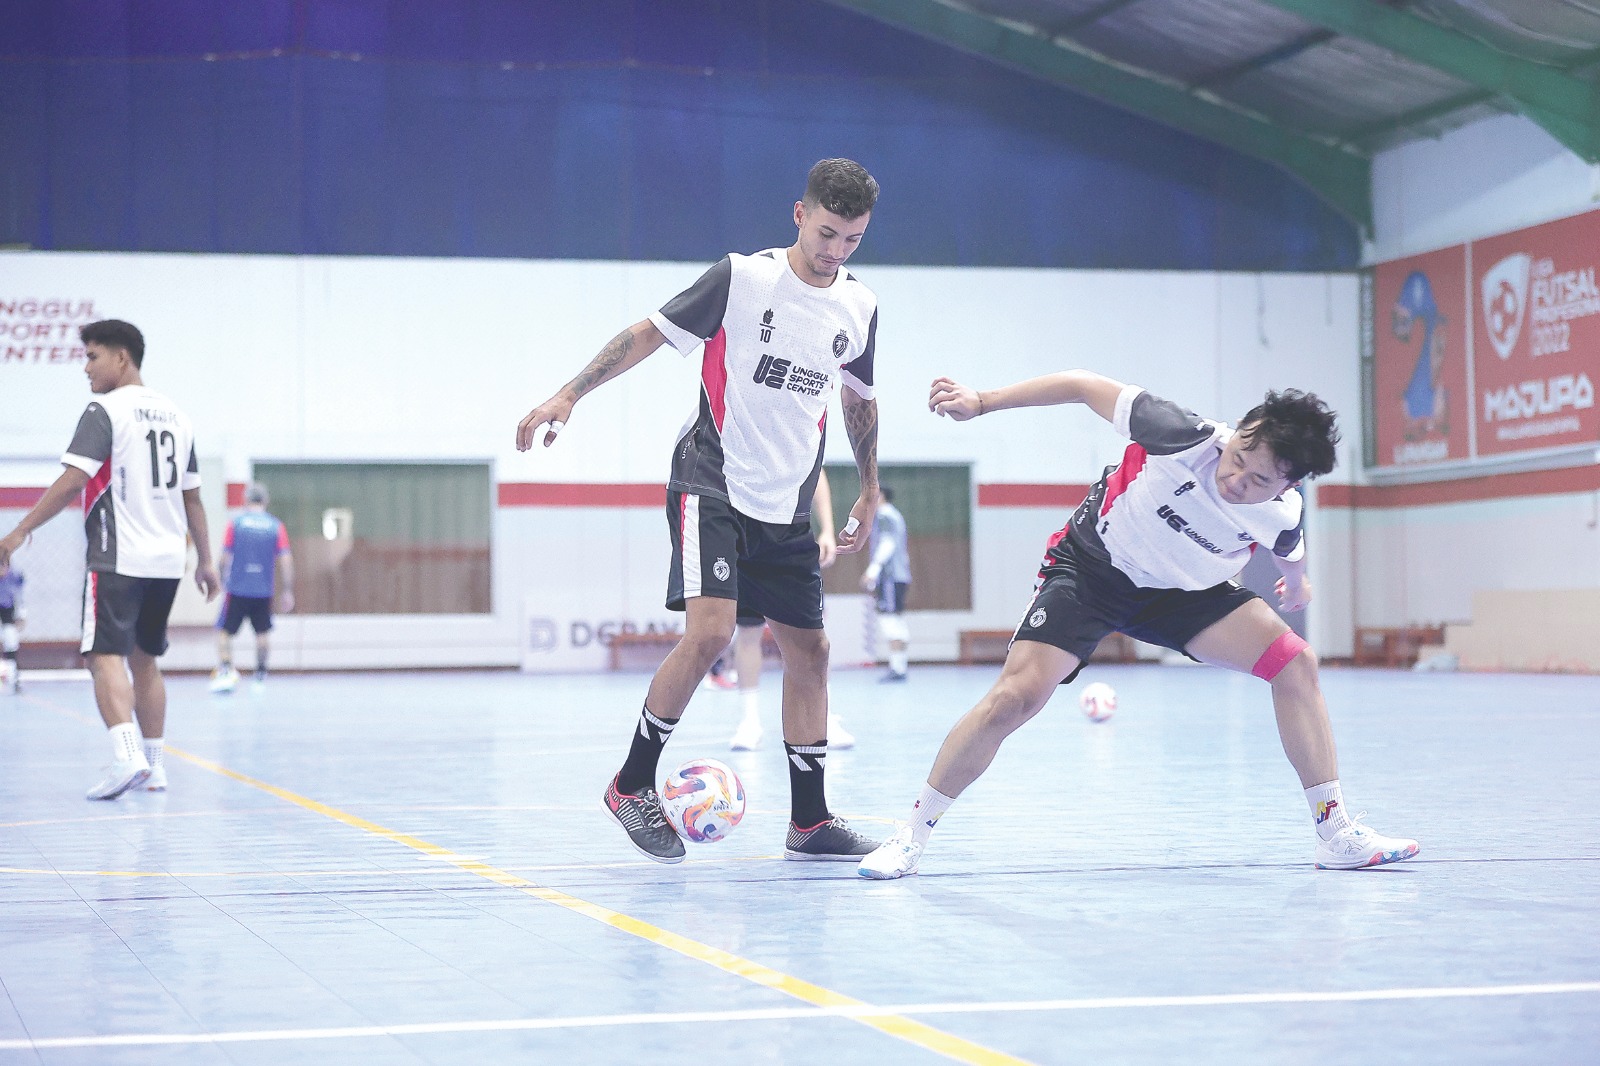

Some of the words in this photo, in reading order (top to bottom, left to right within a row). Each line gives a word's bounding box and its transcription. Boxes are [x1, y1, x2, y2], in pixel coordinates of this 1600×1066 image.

[760, 328, 772, 343] 10
[792, 365, 829, 382] UNGGUL
[786, 382, 821, 396] CENTER
[788, 374, 825, 389] SPORTS
[145, 429, 178, 489] 13
